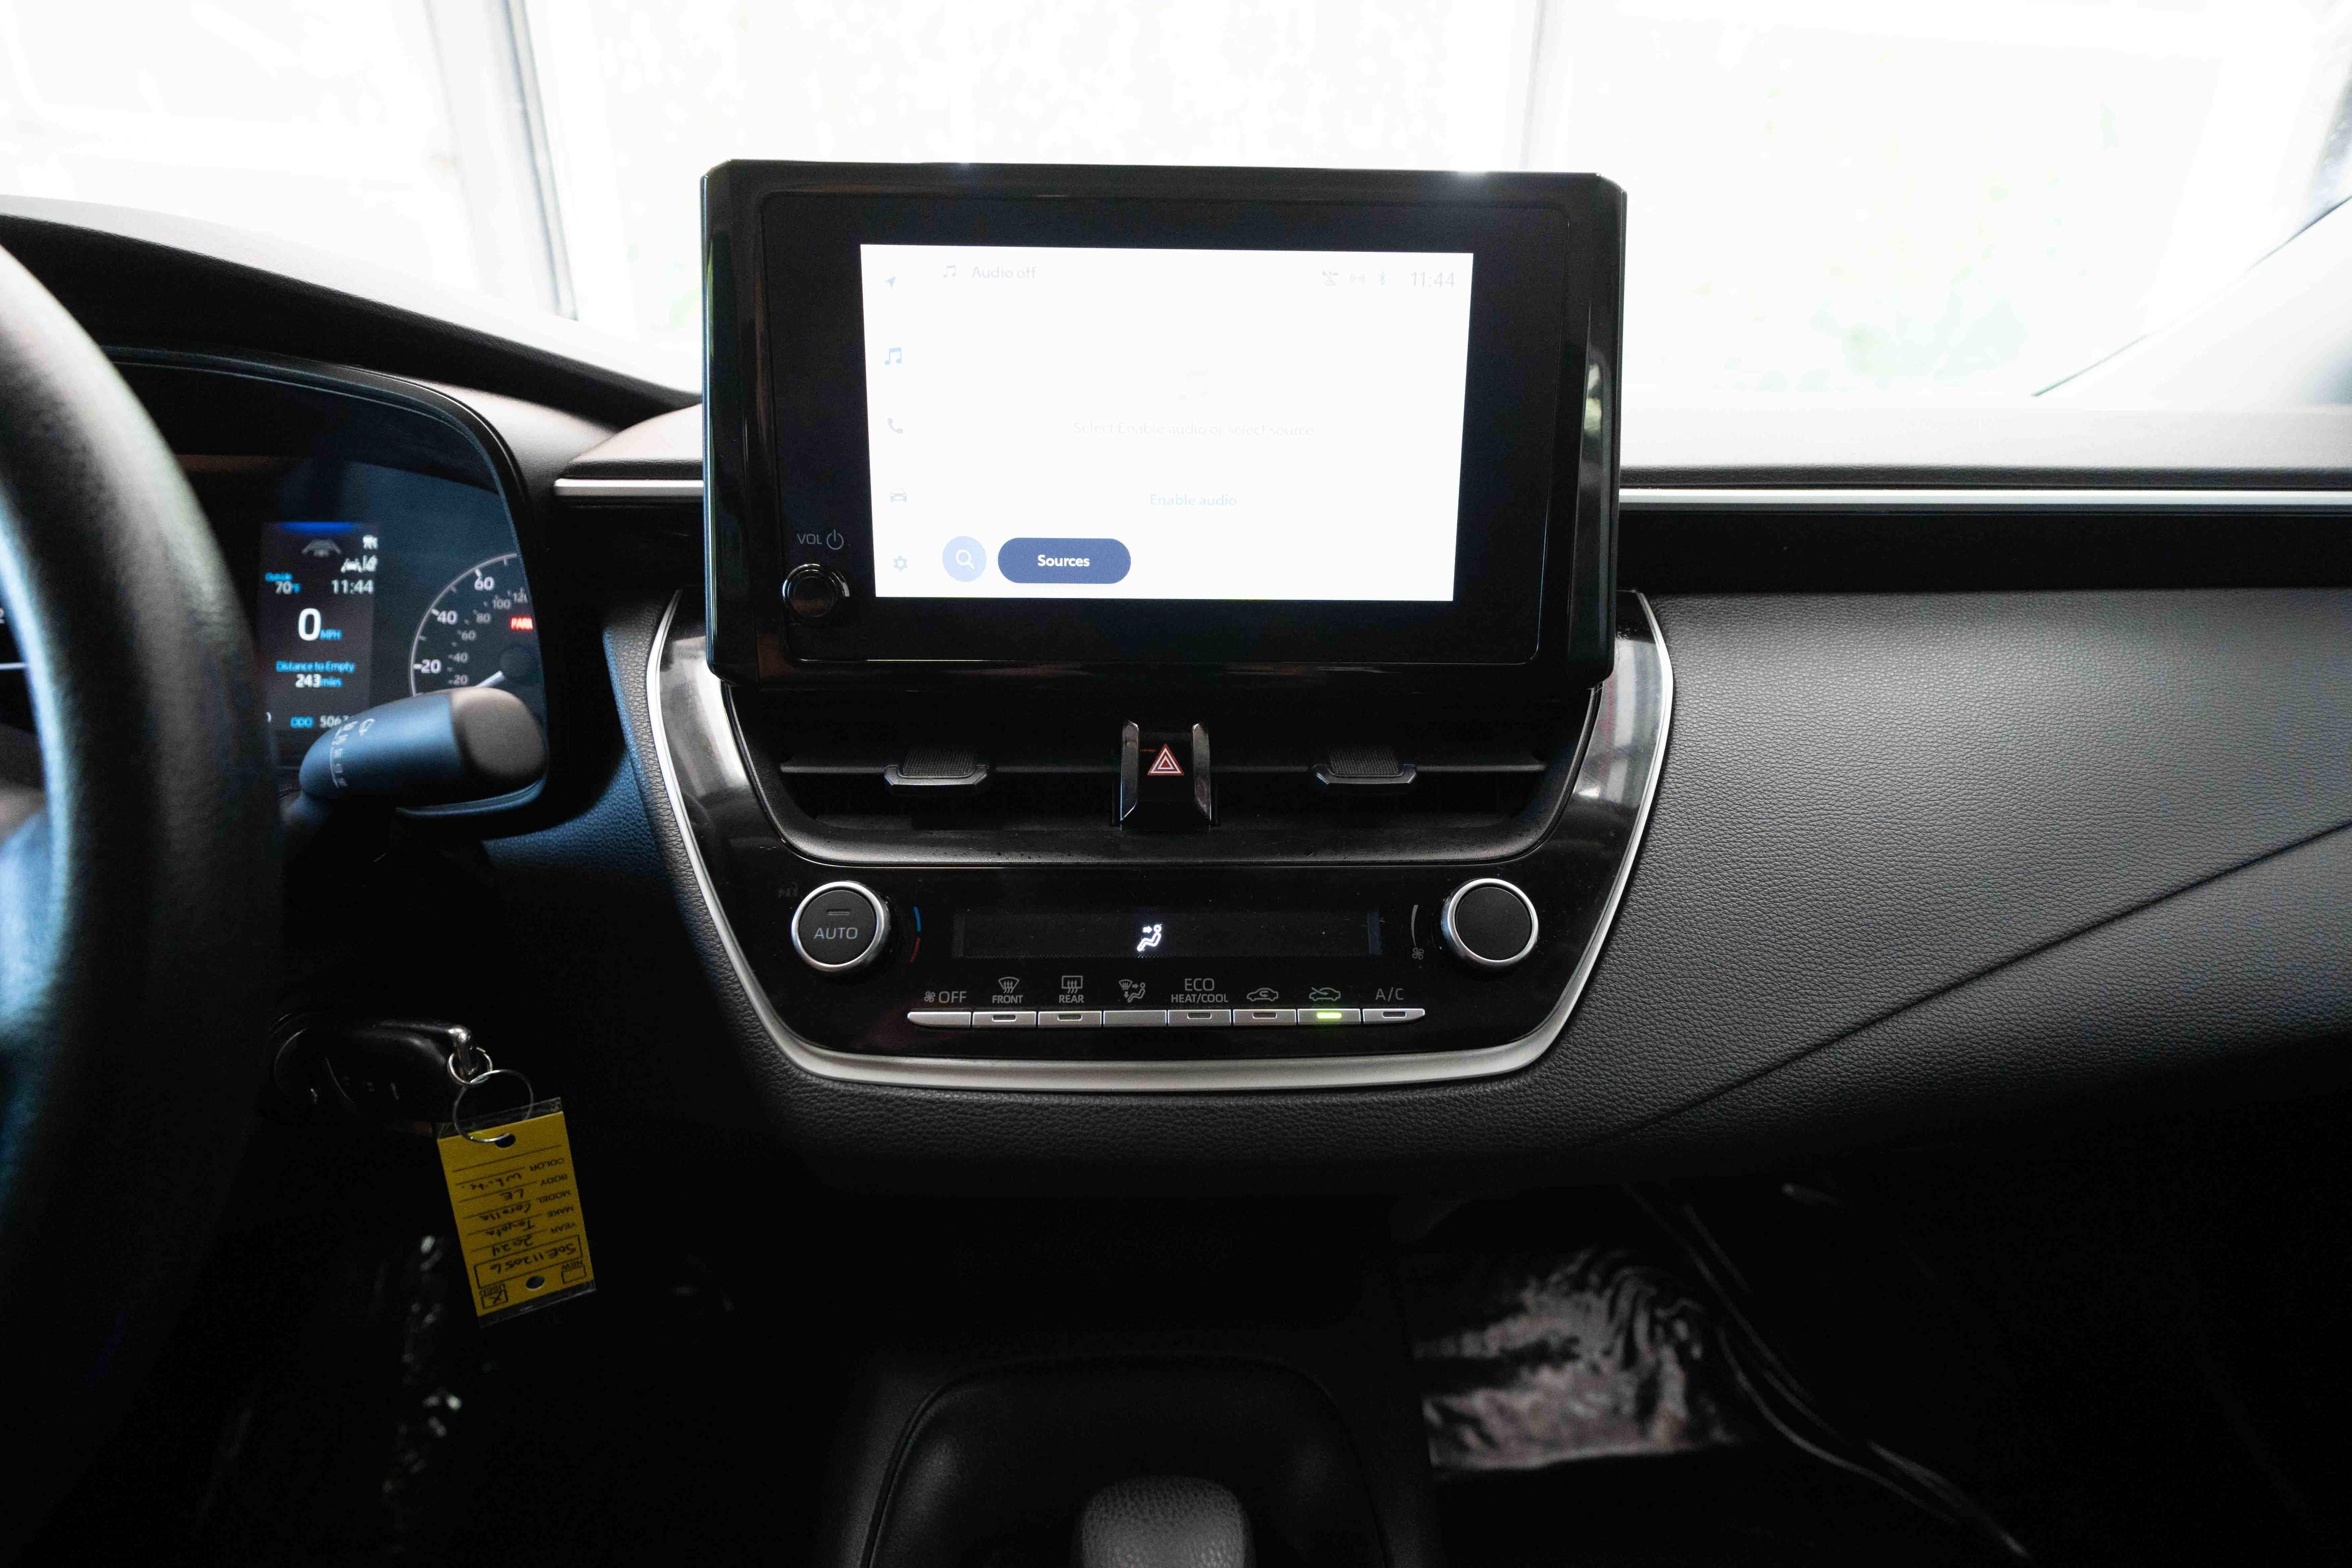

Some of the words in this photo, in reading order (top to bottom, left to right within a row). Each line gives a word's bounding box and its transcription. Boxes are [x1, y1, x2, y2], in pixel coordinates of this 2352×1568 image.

[971, 265, 1013, 280] Audio
[1016, 265, 1037, 279] off
[1411, 271, 1457, 288] 11:44
[1073, 421, 1114, 435] Select
[1118, 422, 1165, 435] Enable
[1169, 422, 1206, 436] audio
[1227, 424, 1265, 436] select
[1269, 426, 1314, 436] source
[1150, 493, 1196, 506] Enable
[1198, 493, 1237, 506] audio
[797, 533, 822, 545] VOL
[1037, 554, 1090, 568] Sources
[331, 579, 375, 595] 11:44
[474, 576, 495, 591] 60
[492, 598, 512, 610] 100
[298, 607, 323, 641] 0
[321, 629, 344, 641] MPH
[437, 610, 458, 625] 40
[477, 613, 492, 624] 80
[461, 630, 477, 641] 60
[453, 652, 468, 663] 40
[275, 660, 313, 672] Distance
[325, 661, 355, 674] Empty
[421, 659, 442, 674] 20
[295, 673, 322, 688] 243
[321, 677, 343, 688] miles
[453, 675, 468, 686] 20
[813, 927, 858, 940] AUTO
[1184, 978, 1215, 991] ECO
[938, 990, 967, 1004] OFF
[992, 995, 1023, 1004] FRONT
[1059, 994, 1085, 1003] REAR
[1171, 993, 1229, 1004] HEAT/COOL
[1375, 987, 1404, 1001] A/C
[529, 1158, 565, 1172] COLOR
[540, 1174, 569, 1186] BODY
[499, 1188, 524, 1201] LE
[536, 1190, 571, 1204] MODEL
[478, 1202, 532, 1221] Corolla
[547, 1205, 575, 1218] MAKE
[484, 1219, 535, 1238] Toyota
[550, 1222, 577, 1234] YEAR
[491, 1234, 534, 1256] 2024
